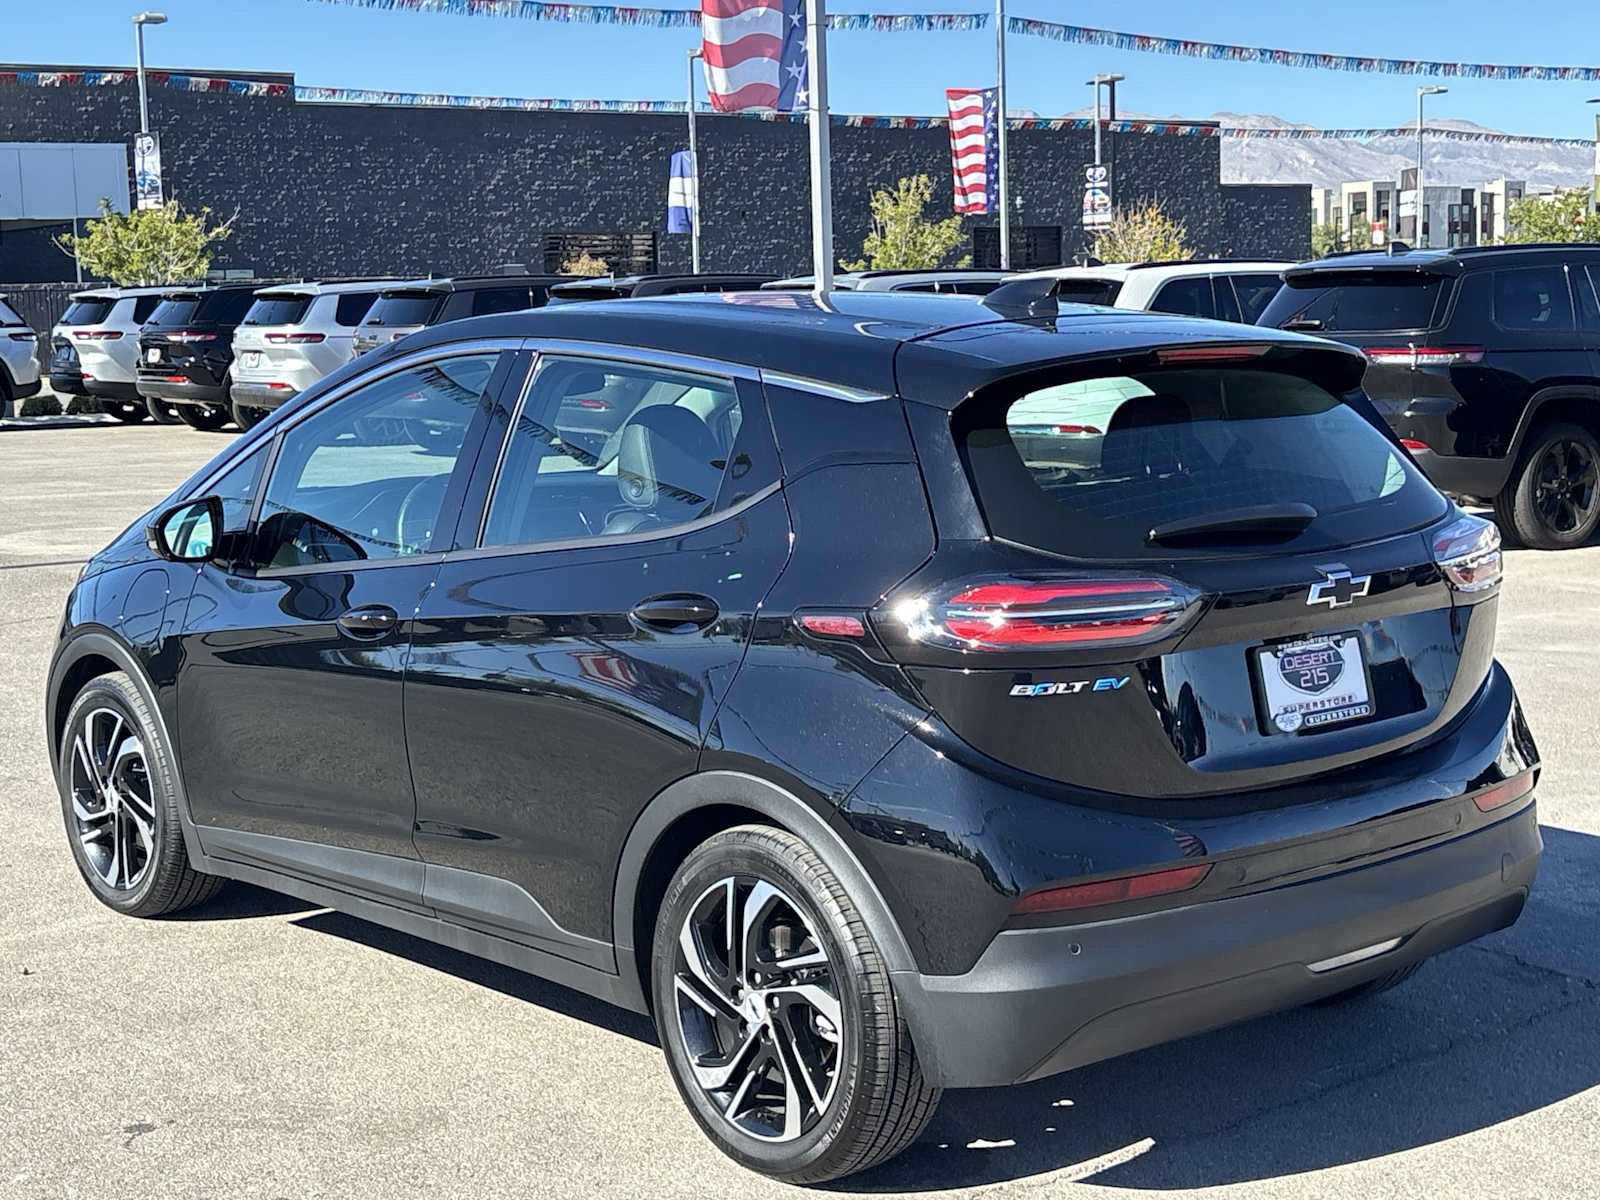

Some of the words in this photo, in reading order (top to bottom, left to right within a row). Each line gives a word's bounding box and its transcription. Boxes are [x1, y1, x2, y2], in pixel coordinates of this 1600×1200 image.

[1284, 650, 1335, 669] DESERT
[1009, 681, 1090, 696] BOLT
[1092, 676, 1131, 692] EV
[1300, 667, 1329, 688] 215
[1283, 695, 1353, 713] SUPERSTORE
